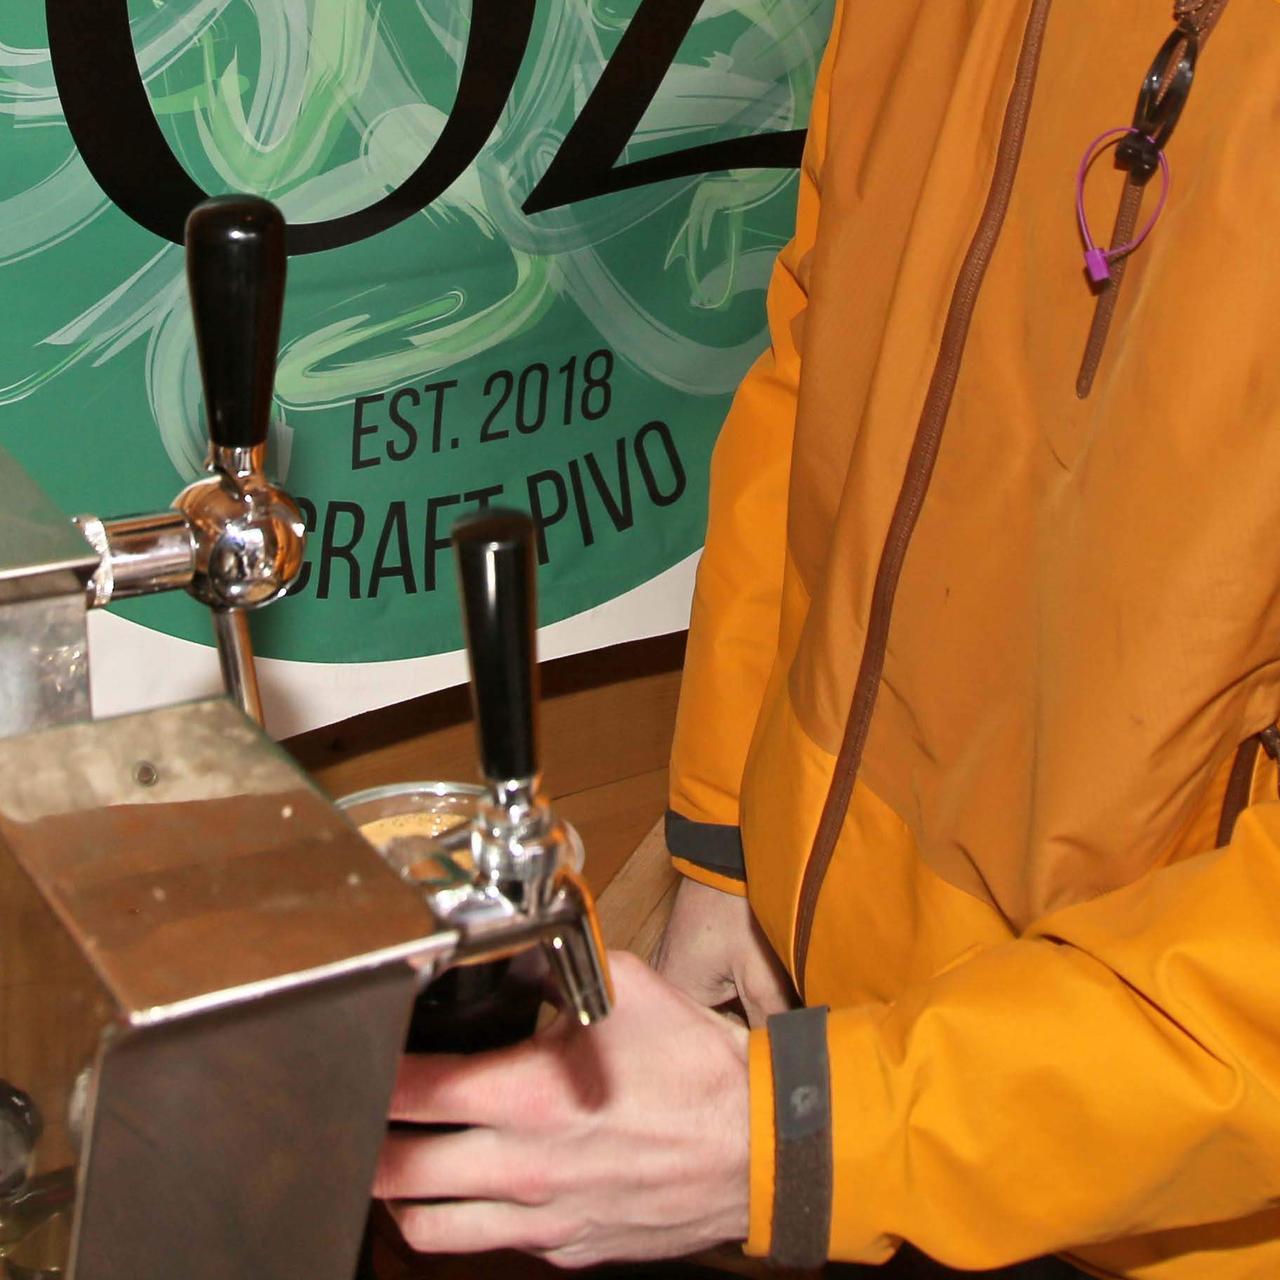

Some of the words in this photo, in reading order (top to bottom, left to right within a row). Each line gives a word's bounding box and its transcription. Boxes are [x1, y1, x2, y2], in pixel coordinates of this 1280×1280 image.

[351, 379, 460, 471] EST.
[479, 348, 614, 444] 2018
[525, 420, 688, 567] PIVO
